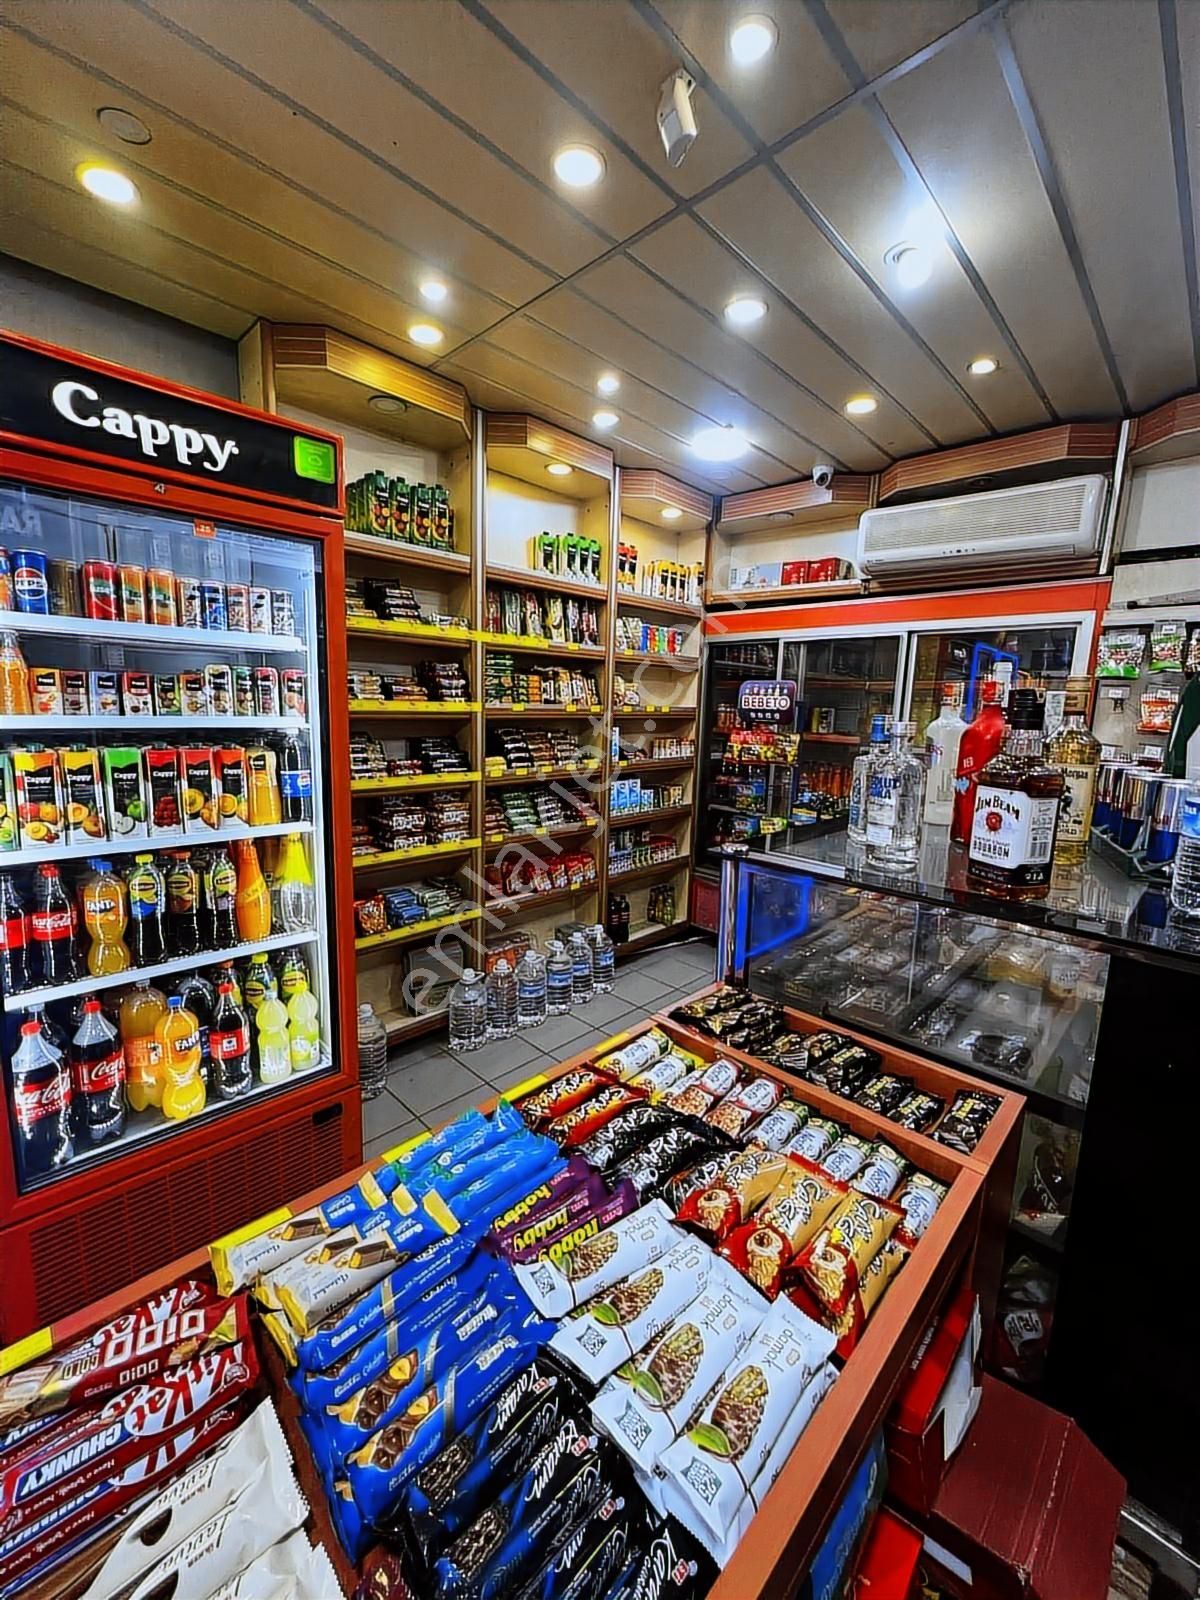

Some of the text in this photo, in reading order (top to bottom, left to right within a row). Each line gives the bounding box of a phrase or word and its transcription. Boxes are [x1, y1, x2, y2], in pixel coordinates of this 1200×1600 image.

[52, 381, 239, 471] Cappy
[742, 695, 790, 711] BEBETO
[976, 795, 1020, 821] JIM BEAM
[973, 840, 1010, 858] BOURBON
[825, 1149, 853, 1173] Nesfit
[865, 1164, 892, 1193] Nesfit
[494, 1184, 552, 1232] hobby
[513, 1207, 570, 1253] hobby
[621, 1215, 659, 1243] damak
[775, 1178, 822, 1237] CANGA
[834, 1199, 881, 1255] CANGA
[700, 1294, 732, 1336] damak
[760, 1326, 794, 1373] damak
[489, 1362, 540, 1434] Karam
[21, 1423, 123, 1496] CHUNKY
[525, 1419, 578, 1502] Karam
